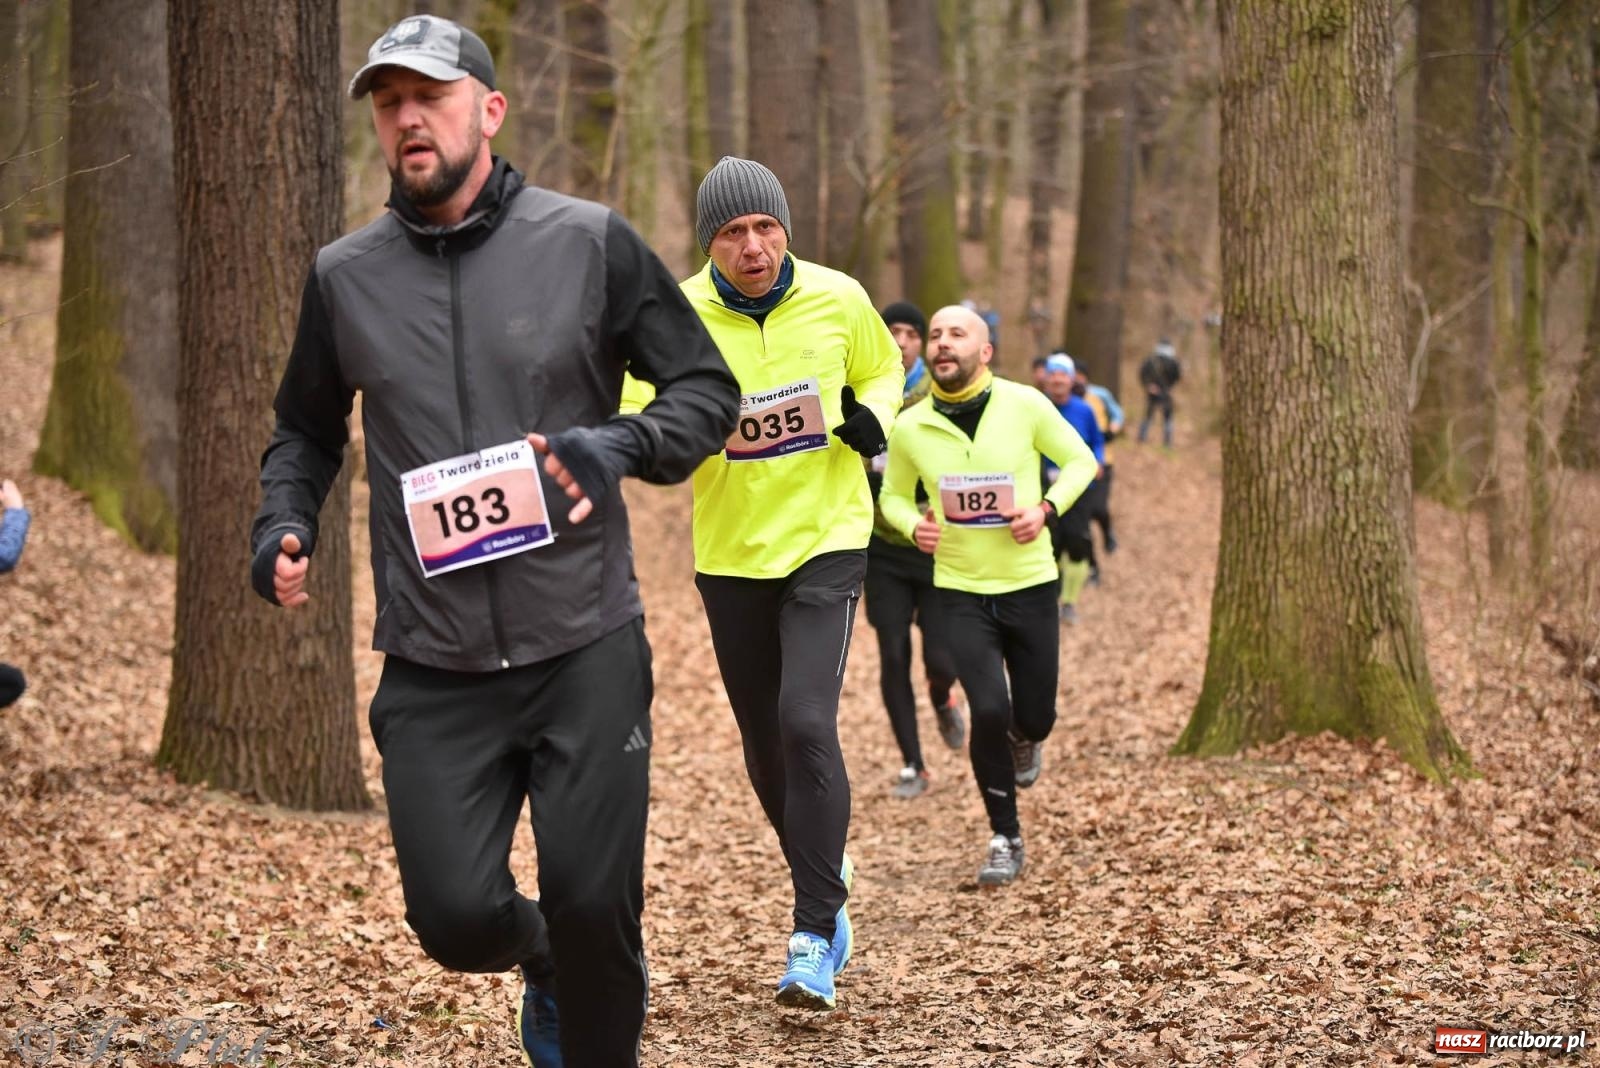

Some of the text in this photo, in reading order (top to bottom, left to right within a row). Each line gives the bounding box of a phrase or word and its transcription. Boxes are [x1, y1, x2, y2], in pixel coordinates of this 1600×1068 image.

[750, 383, 809, 405] Twardziela
[739, 406, 805, 442] 035
[411, 451, 520, 488] BIEG Twardziela
[432, 487, 510, 539] 183
[956, 491, 998, 512] 182
